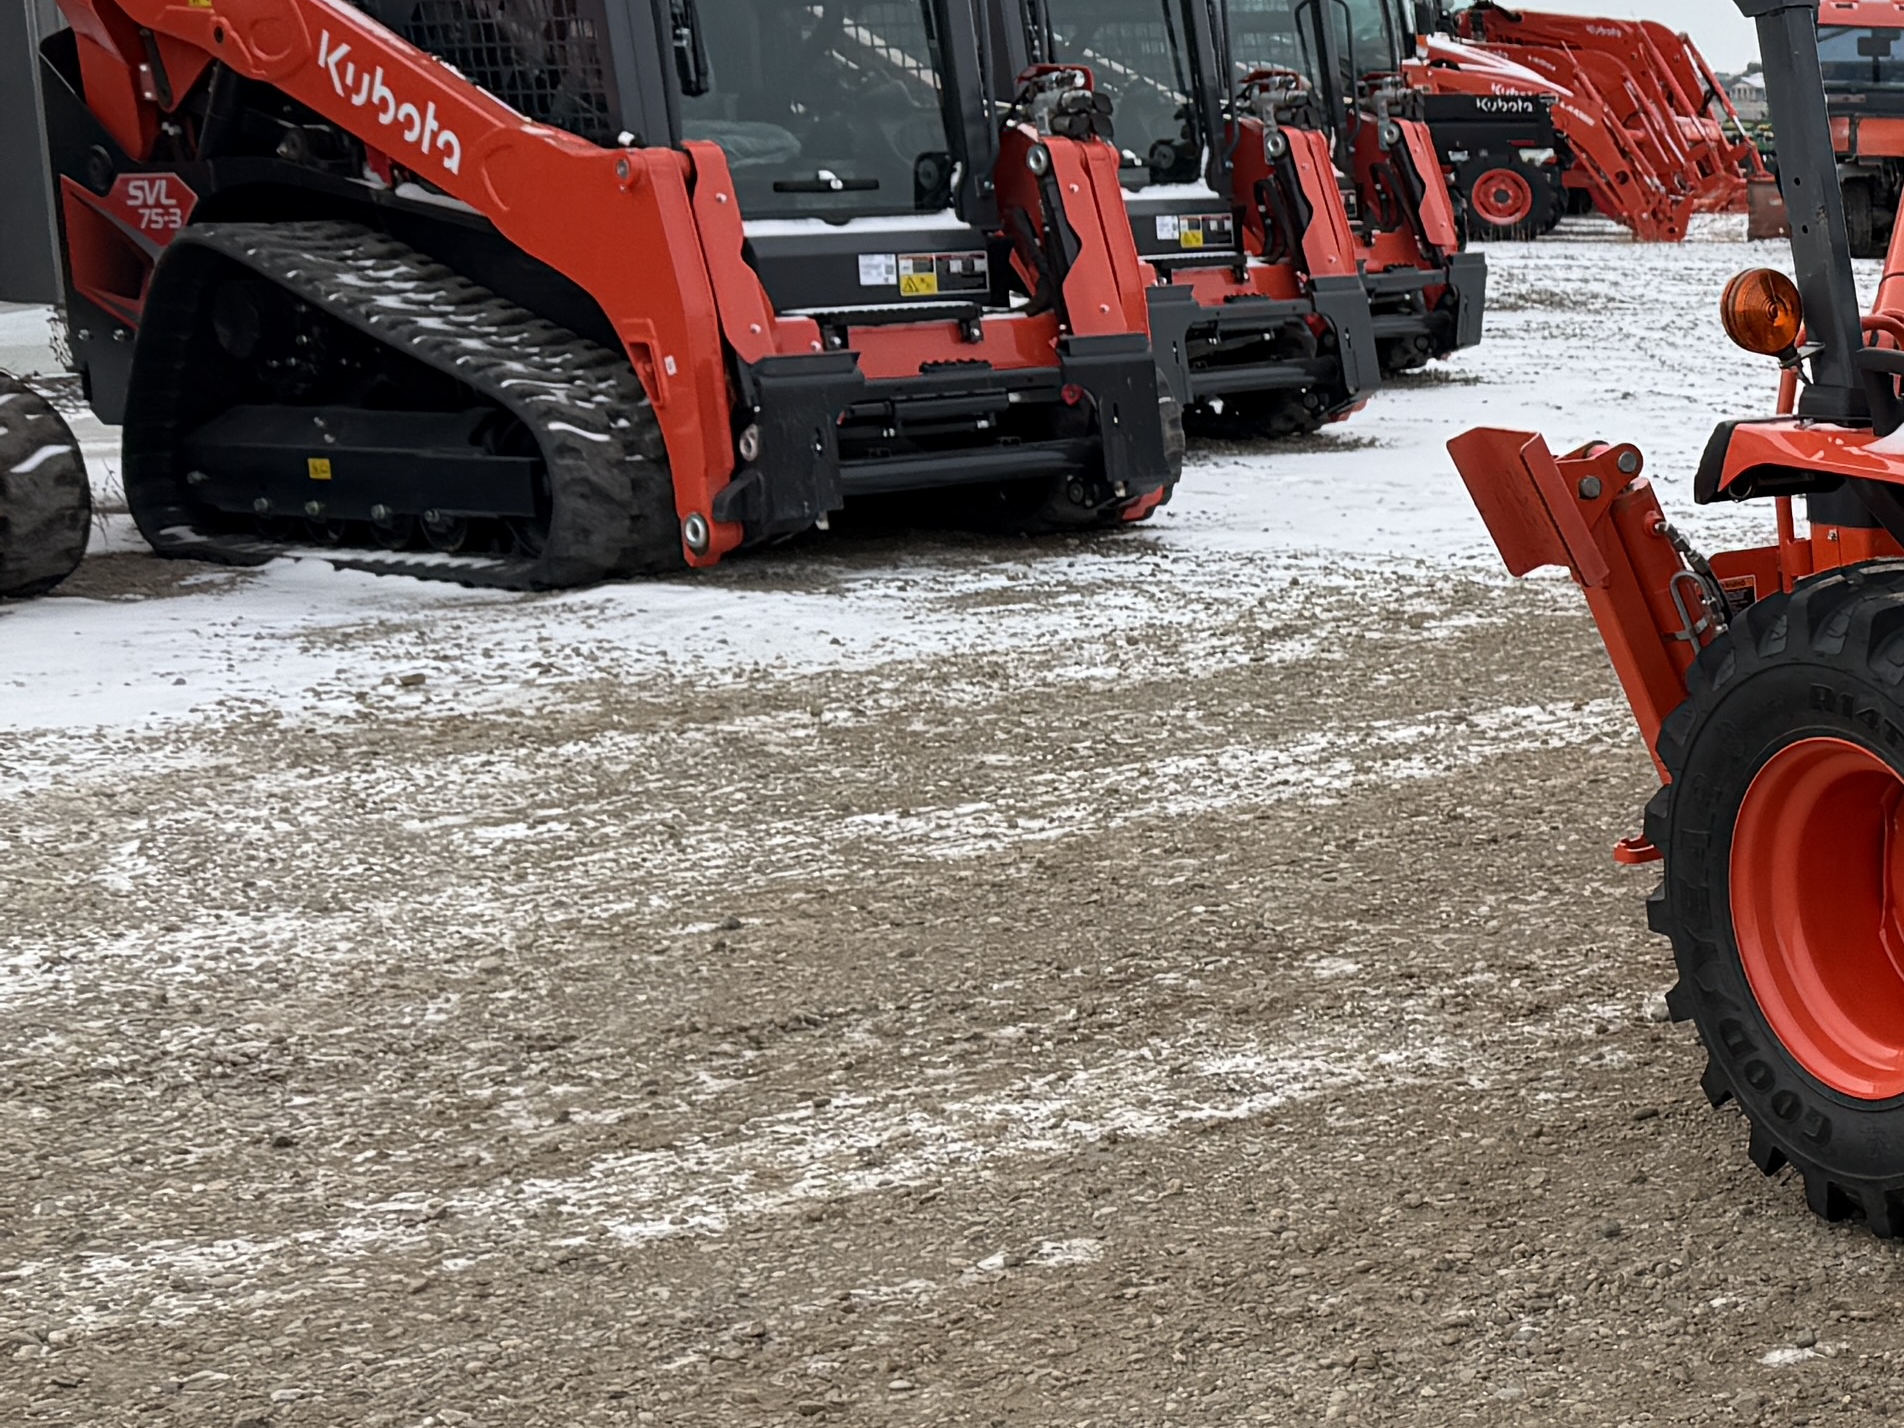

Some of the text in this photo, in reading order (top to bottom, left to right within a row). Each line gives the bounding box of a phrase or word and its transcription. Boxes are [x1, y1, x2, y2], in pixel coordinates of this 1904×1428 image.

[318, 28, 462, 176] Kubota
[1476, 97, 1534, 112] Kubota
[126, 179, 177, 206] SVL
